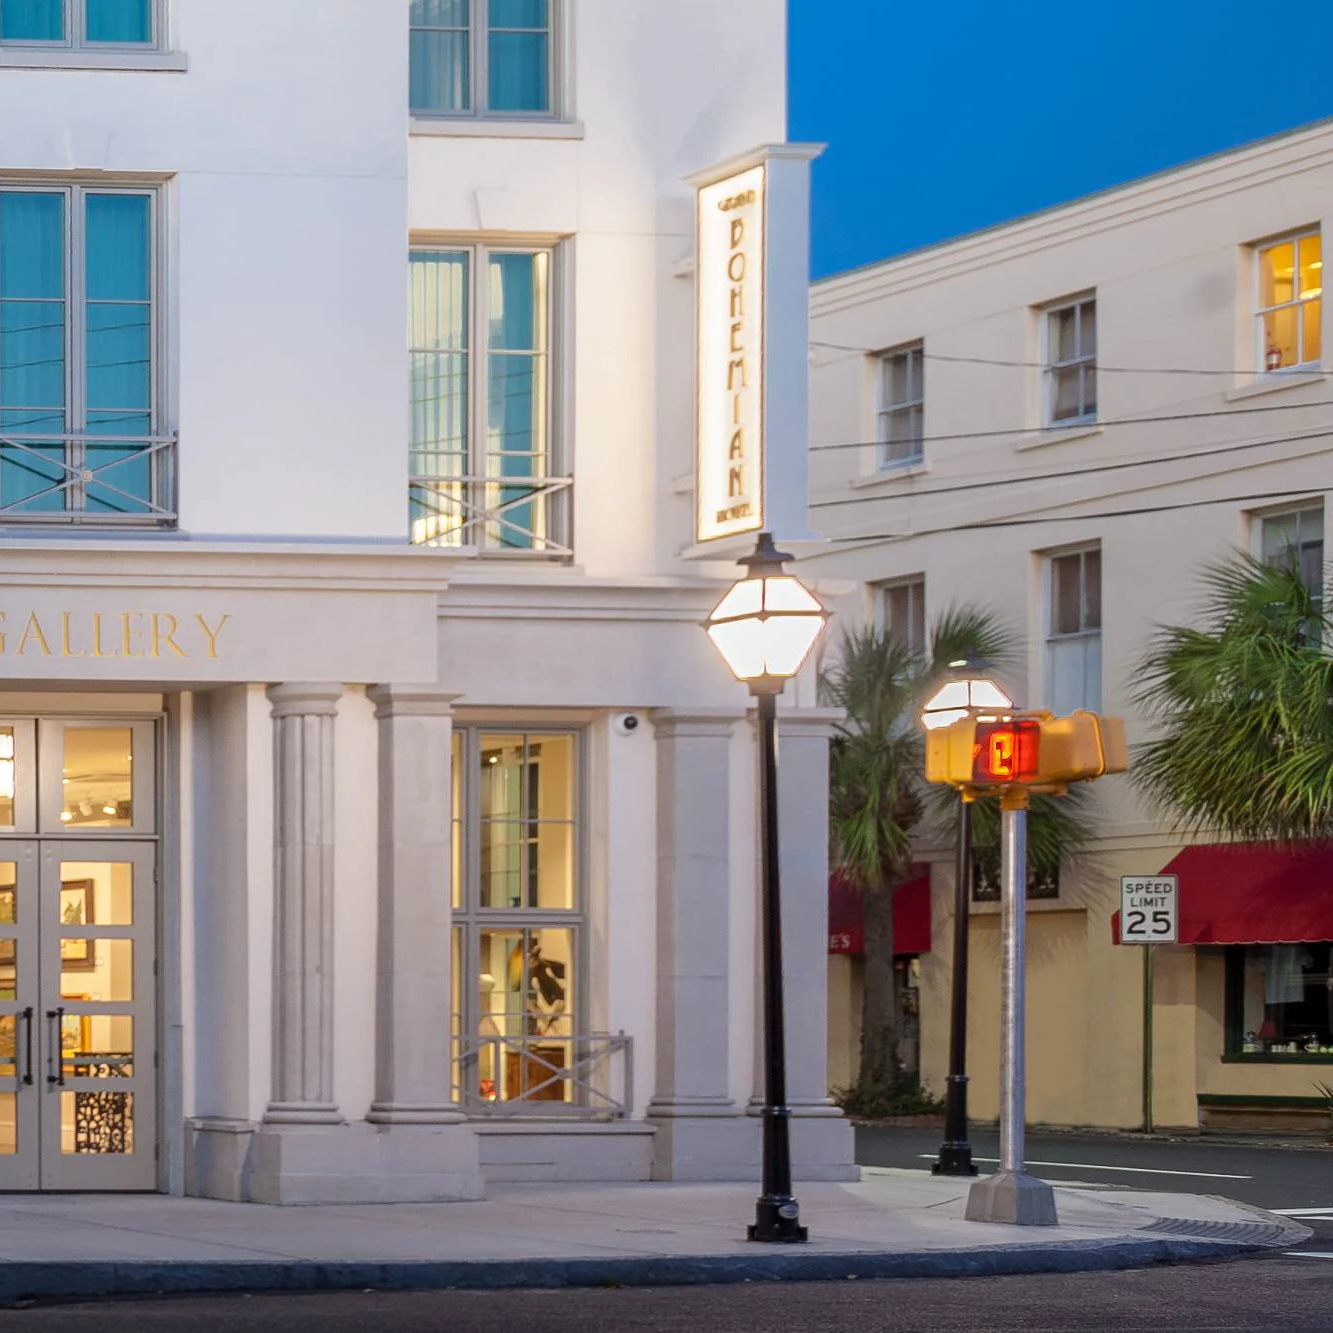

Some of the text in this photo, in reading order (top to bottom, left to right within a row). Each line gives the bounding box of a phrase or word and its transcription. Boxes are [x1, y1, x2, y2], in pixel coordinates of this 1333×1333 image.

[727, 217, 746, 497] BOHEMIAN
[1125, 882, 1173, 894] SPEED
[1130, 896, 1167, 908] LIMIT
[1126, 911, 1172, 935] 25
